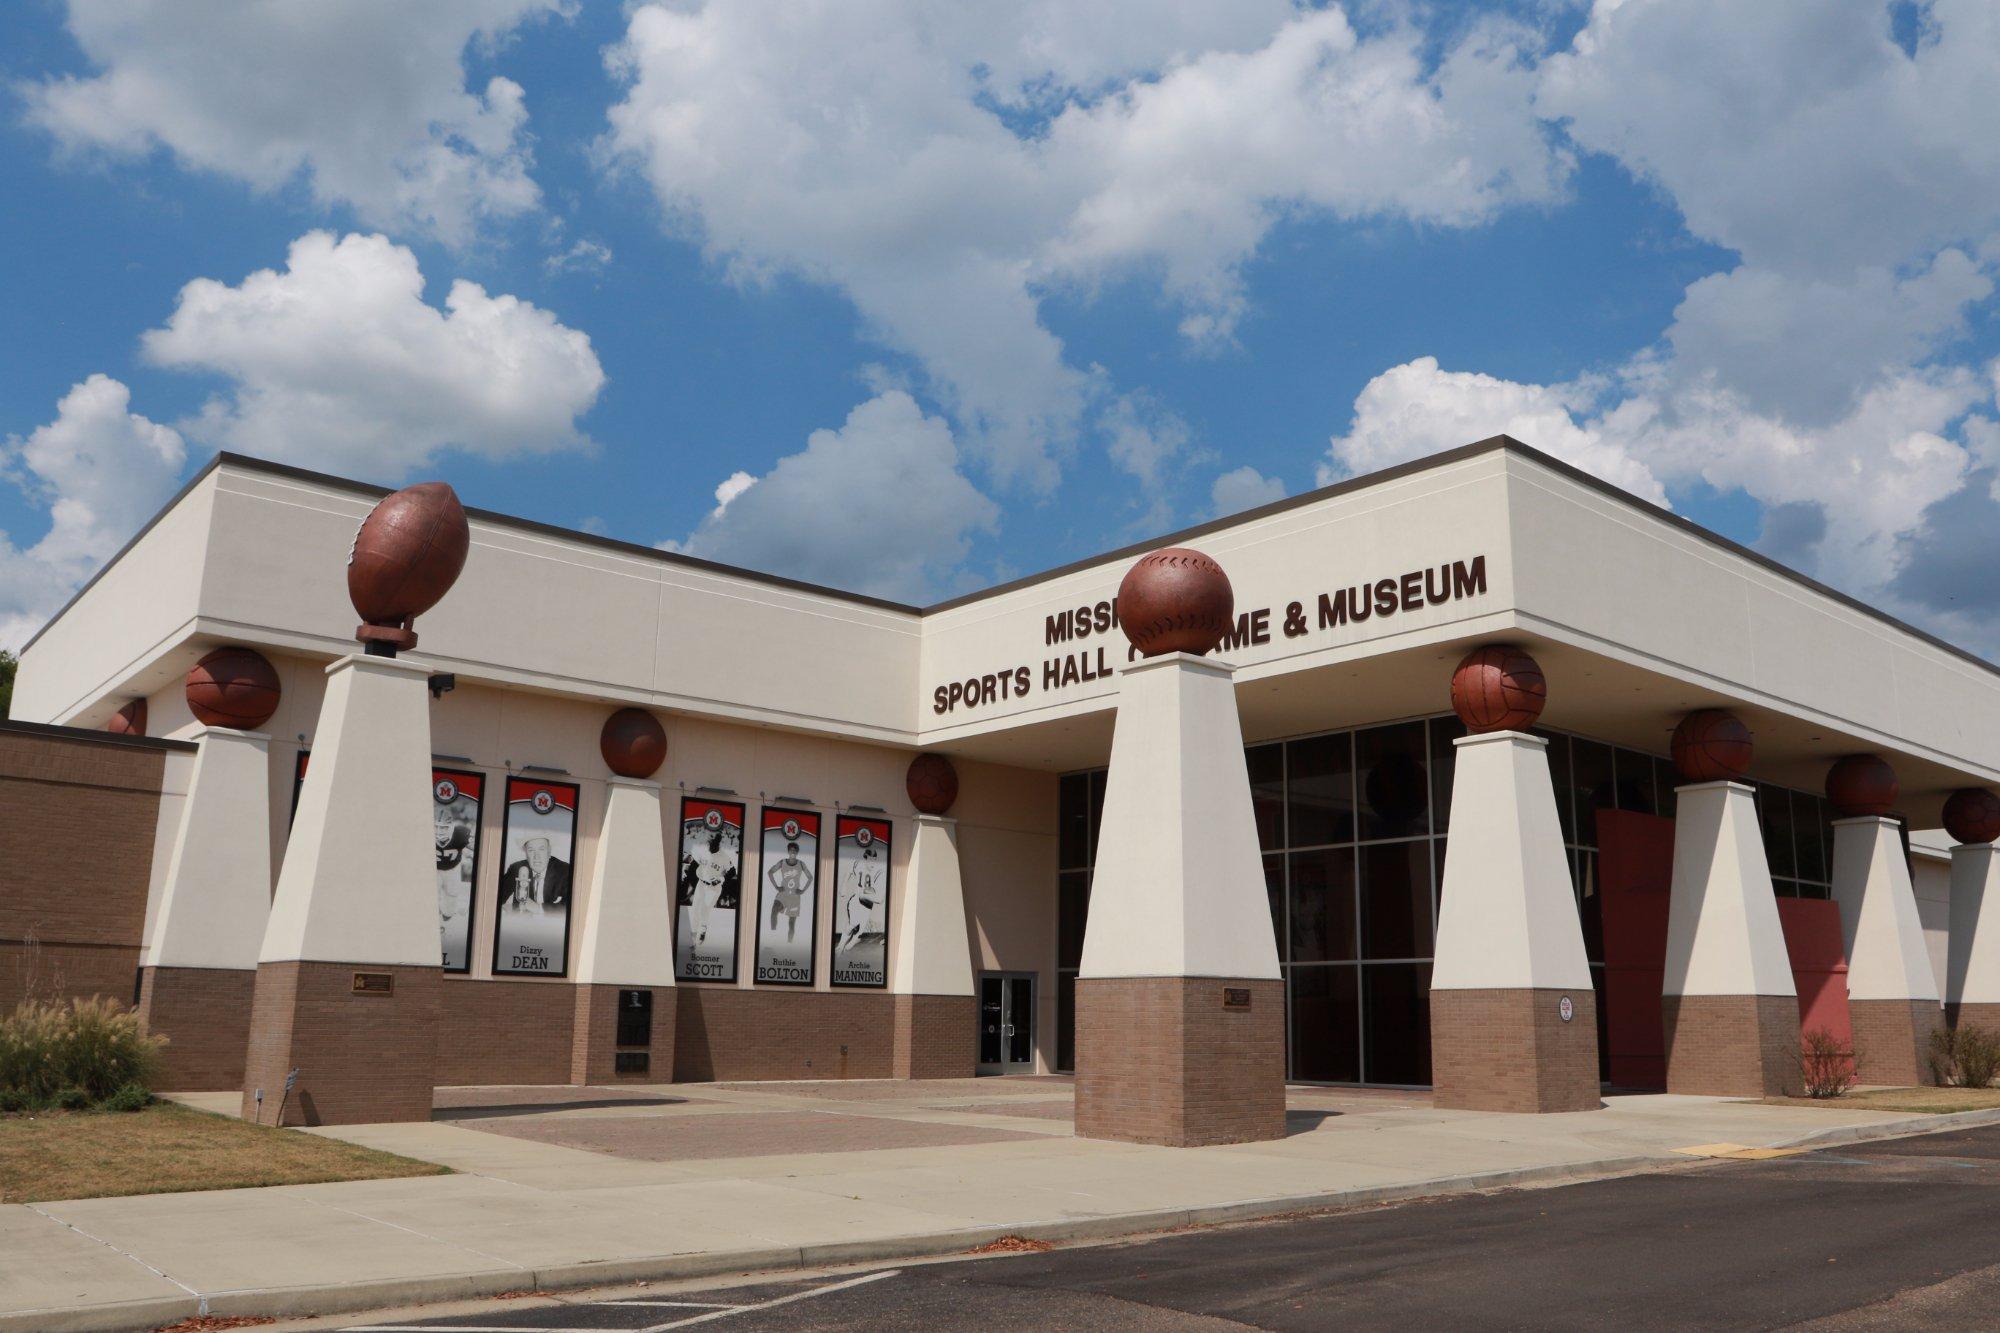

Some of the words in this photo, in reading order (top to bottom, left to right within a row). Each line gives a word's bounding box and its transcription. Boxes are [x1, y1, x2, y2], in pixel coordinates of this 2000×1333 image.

[1046, 597, 1121, 646] MISSI
[933, 666, 1030, 715] SPORTS
[1043, 647, 1113, 691] HALL
[1283, 601, 1309, 638] &
[1318, 555, 1487, 631] MUSEUM
[520, 945, 543, 957] Dizzy
[691, 953, 719, 963] Boomer
[512, 956, 549, 970] DEAN
[773, 957, 797, 967] Ruthie
[848, 961, 870, 970] Archie
[685, 963, 724, 977] SCOTT
[759, 967, 809, 981] BOLTON
[834, 969, 883, 983] MANNING
